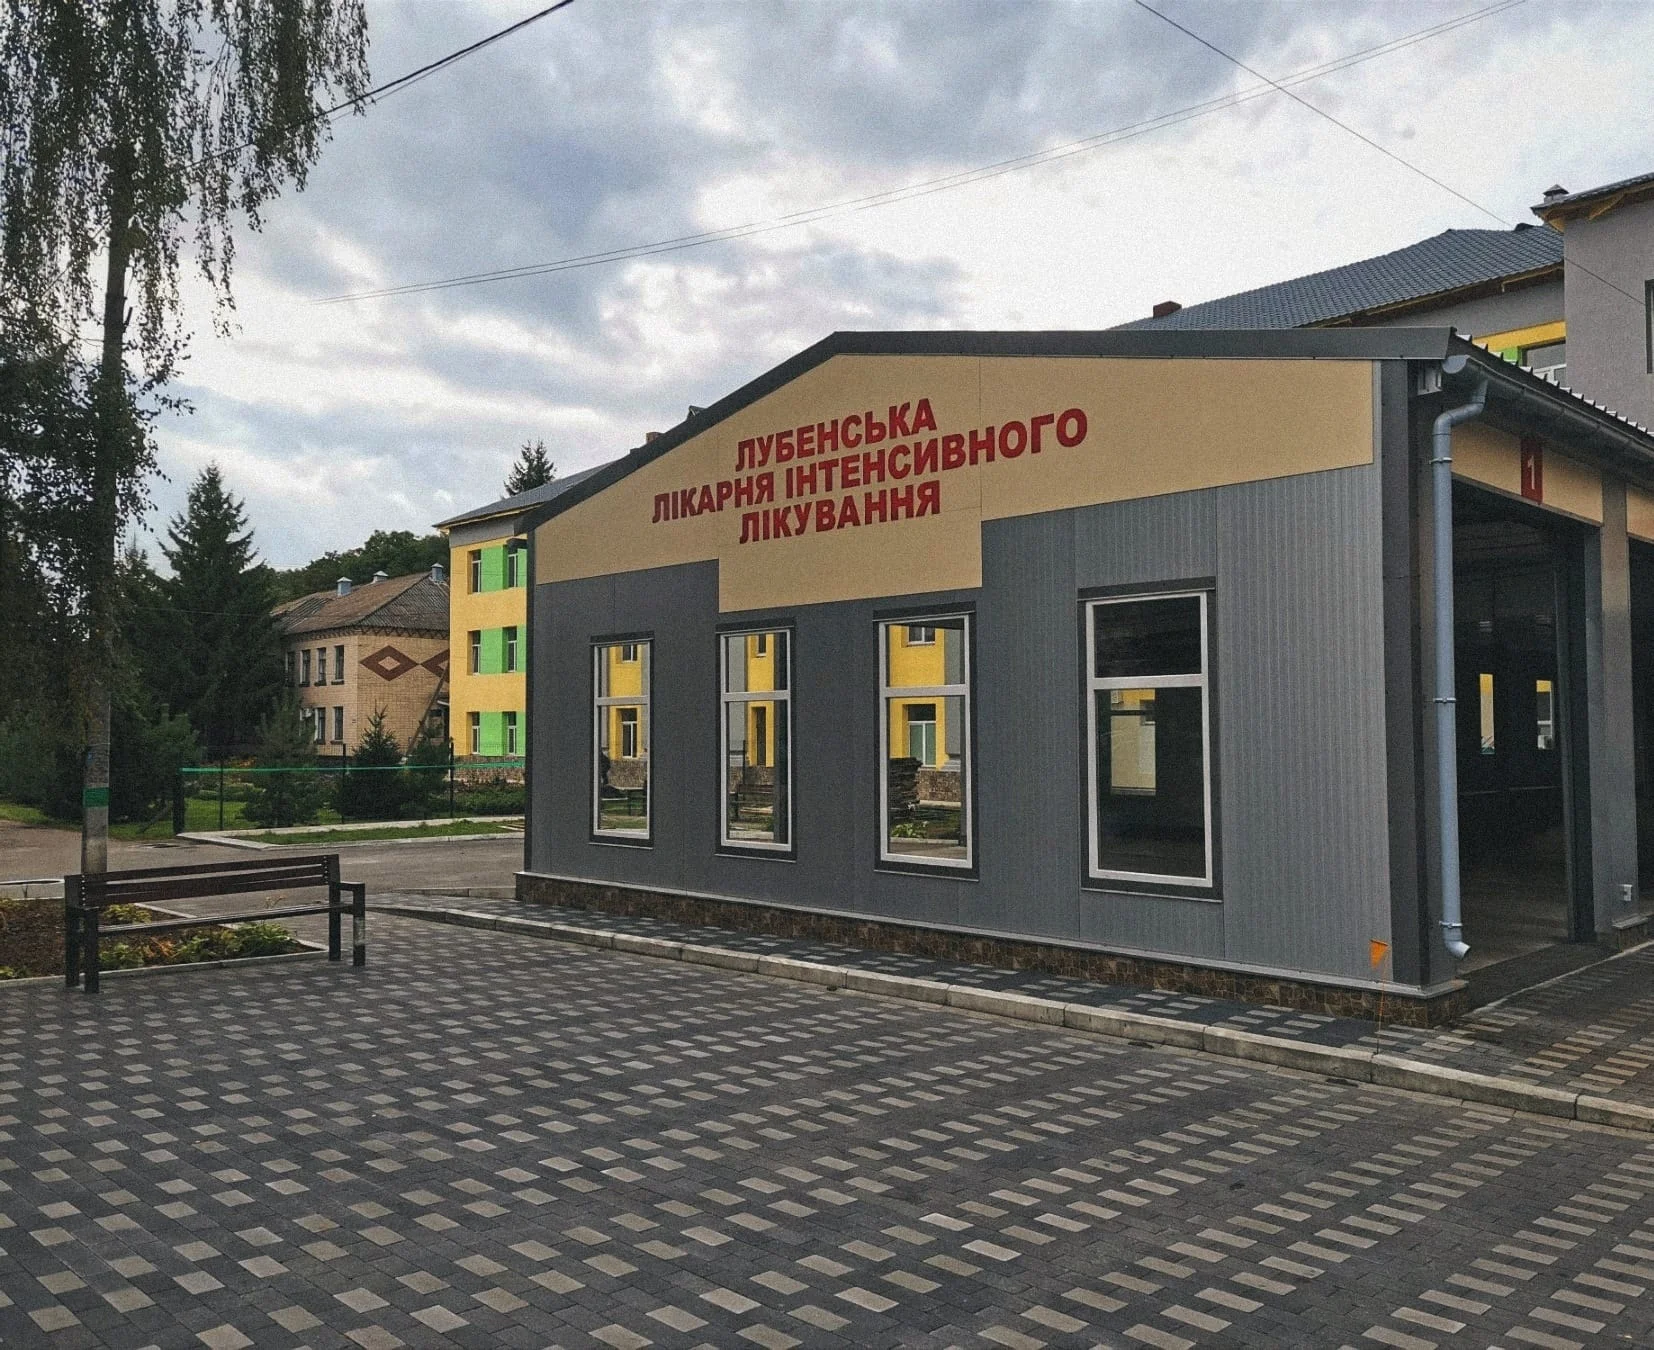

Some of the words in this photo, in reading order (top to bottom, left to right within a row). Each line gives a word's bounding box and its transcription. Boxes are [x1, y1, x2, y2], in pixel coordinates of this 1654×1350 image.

[652, 472, 775, 523] ЛІКАРНЯ
[785, 408, 1088, 498] ІНТЕНСИВНОГО
[735, 398, 937, 472] ЛУБЕНСЬКА
[1527, 455, 1536, 490] 1
[739, 480, 941, 544] ЛІКУВАННЯ
